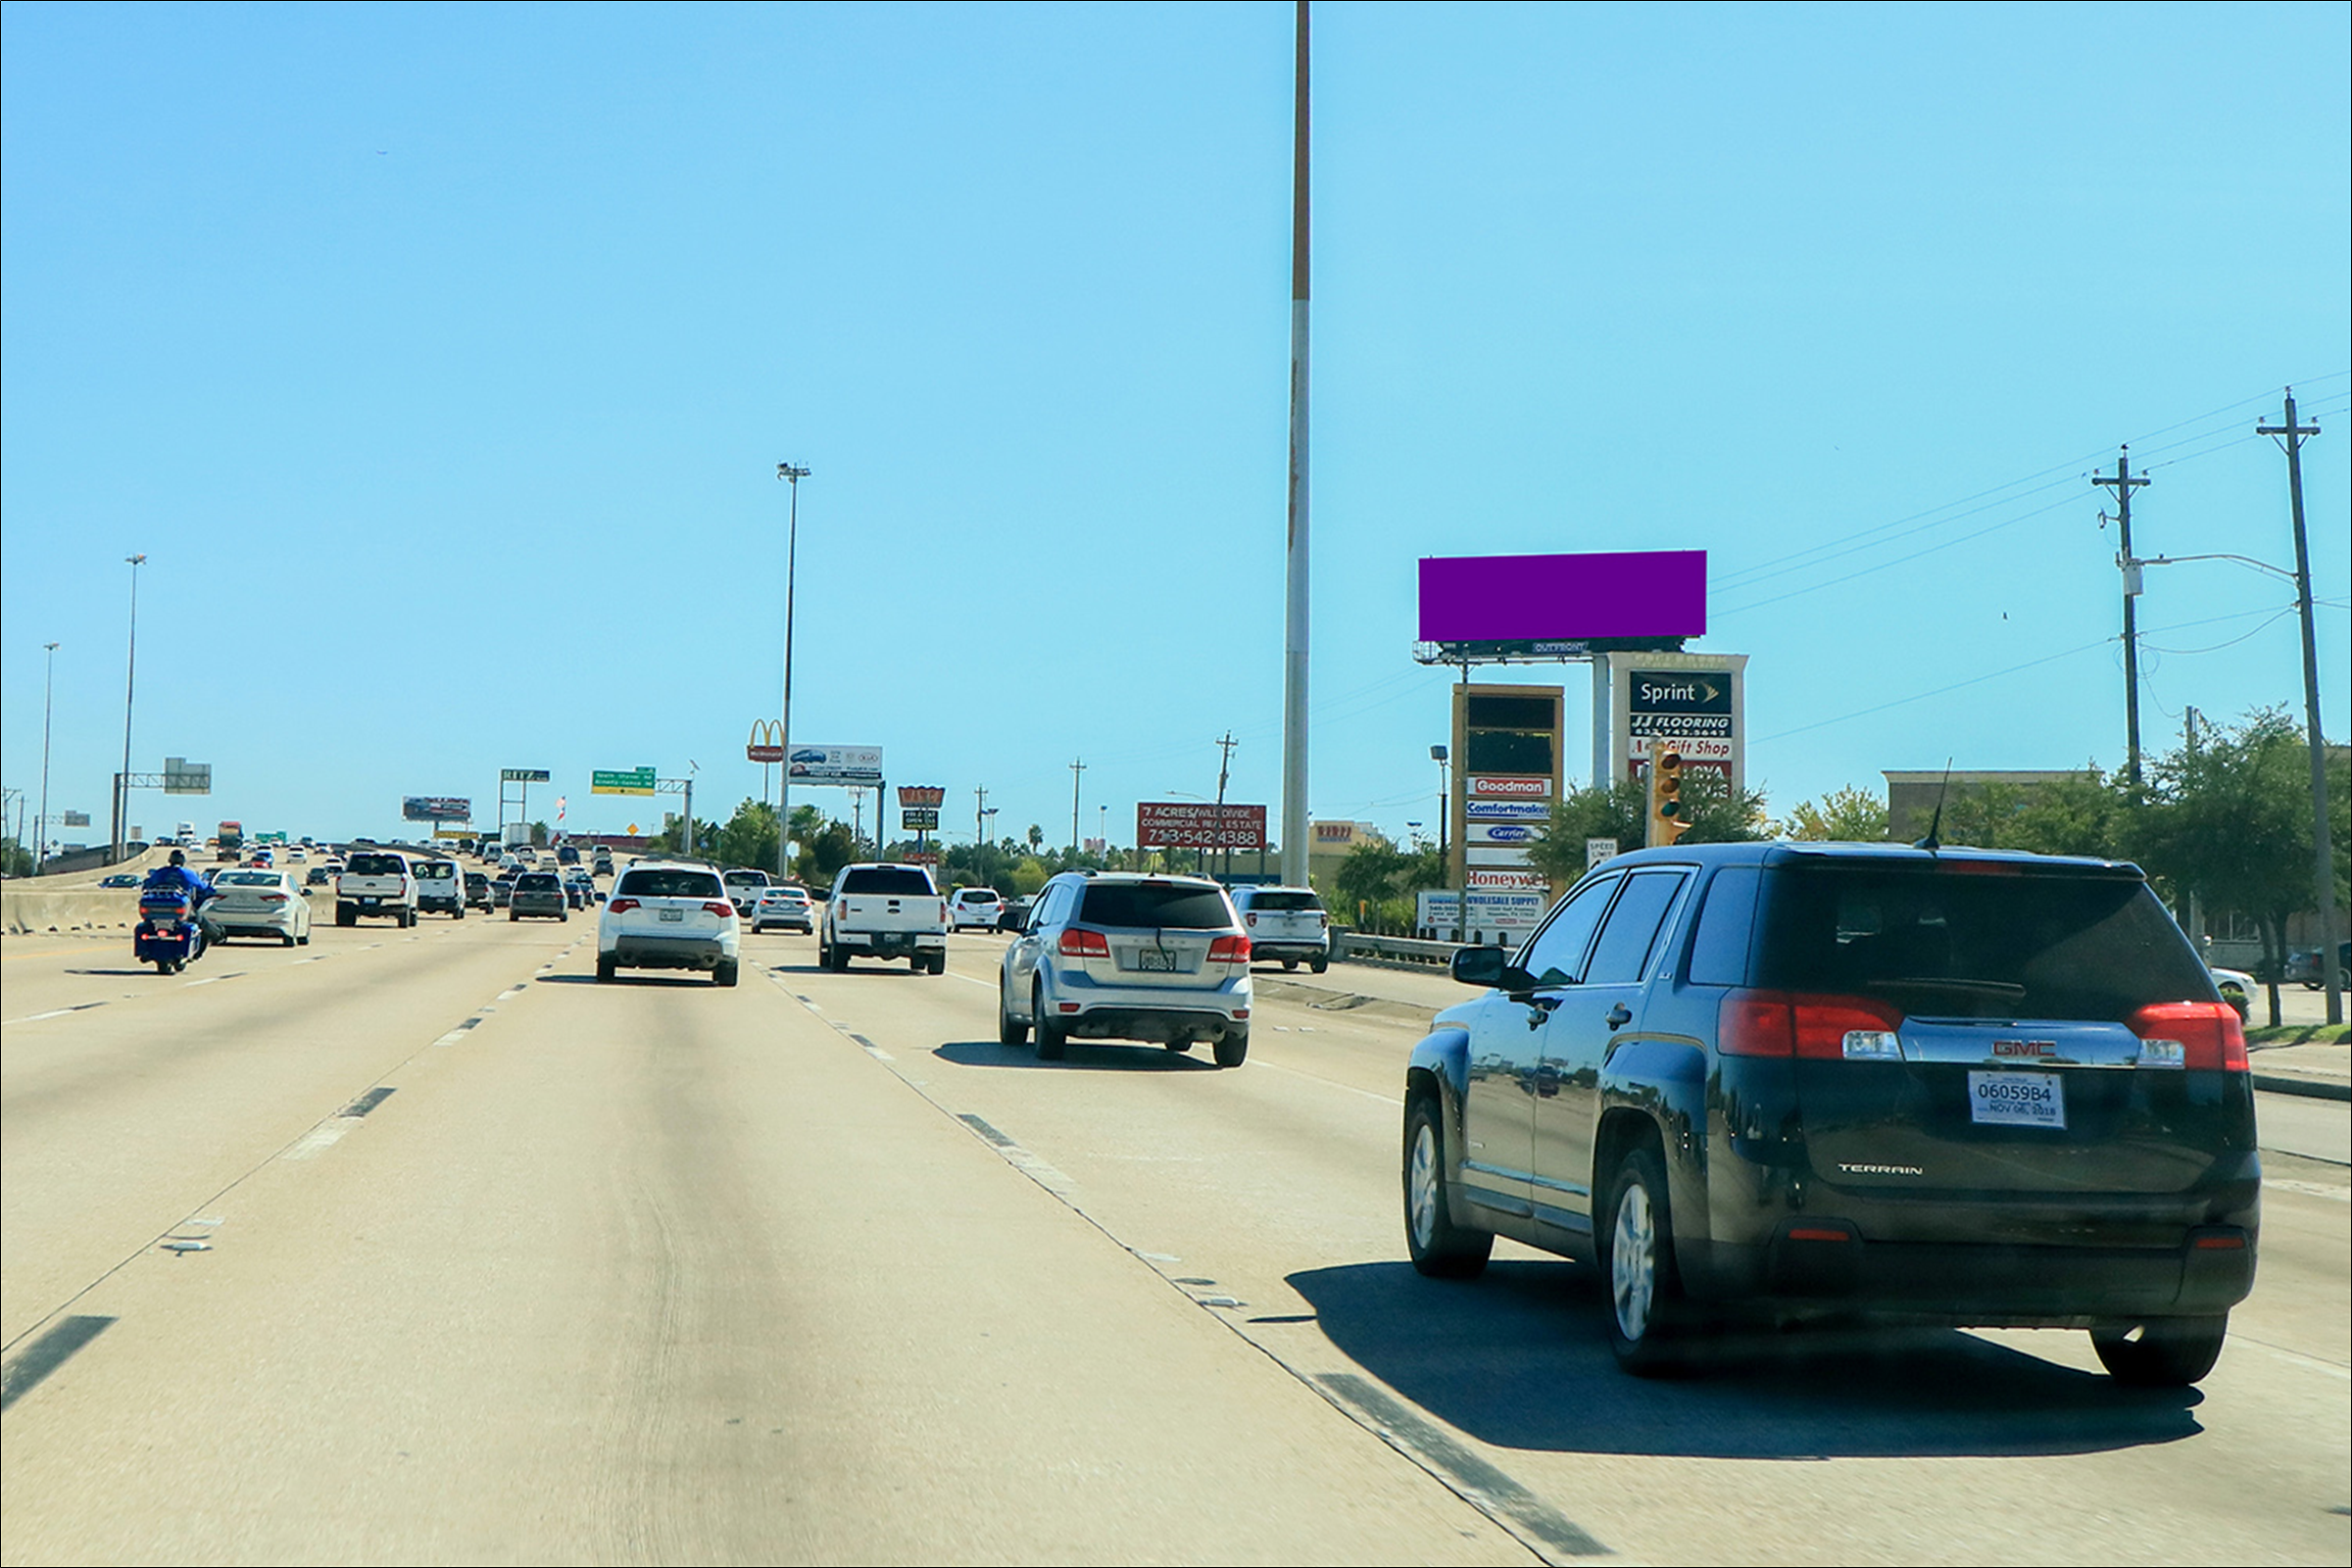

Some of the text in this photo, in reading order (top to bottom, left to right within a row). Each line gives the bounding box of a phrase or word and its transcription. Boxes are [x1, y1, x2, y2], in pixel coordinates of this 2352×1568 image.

[1534, 643, 1586, 653] OUTFRONT
[1641, 683, 1695, 705] Sprint
[1631, 716, 1730, 728] JJ FLOORING
[1667, 740, 1692, 755] Gift
[1695, 740, 1731, 758] Shop
[1477, 780, 1543, 793] Goodman
[1143, 807, 1152, 816] 7
[1142, 817, 1200, 828] COMMERCIAL
[1226, 820, 1262, 830] ESTATE
[1492, 828, 1526, 838] Carrier
[1467, 871, 1549, 889] Honeywel
[1466, 896, 1509, 906] WHOLESALE
[1510, 897, 1540, 906] SUPPLY
[1992, 1041, 2056, 1056] GMC
[1978, 1084, 2051, 1102] 06059B4
[1989, 1102, 2011, 1113] NOV
[2033, 1104, 2056, 1116] 2018
[1838, 1163, 1924, 1175] TERRAIN
